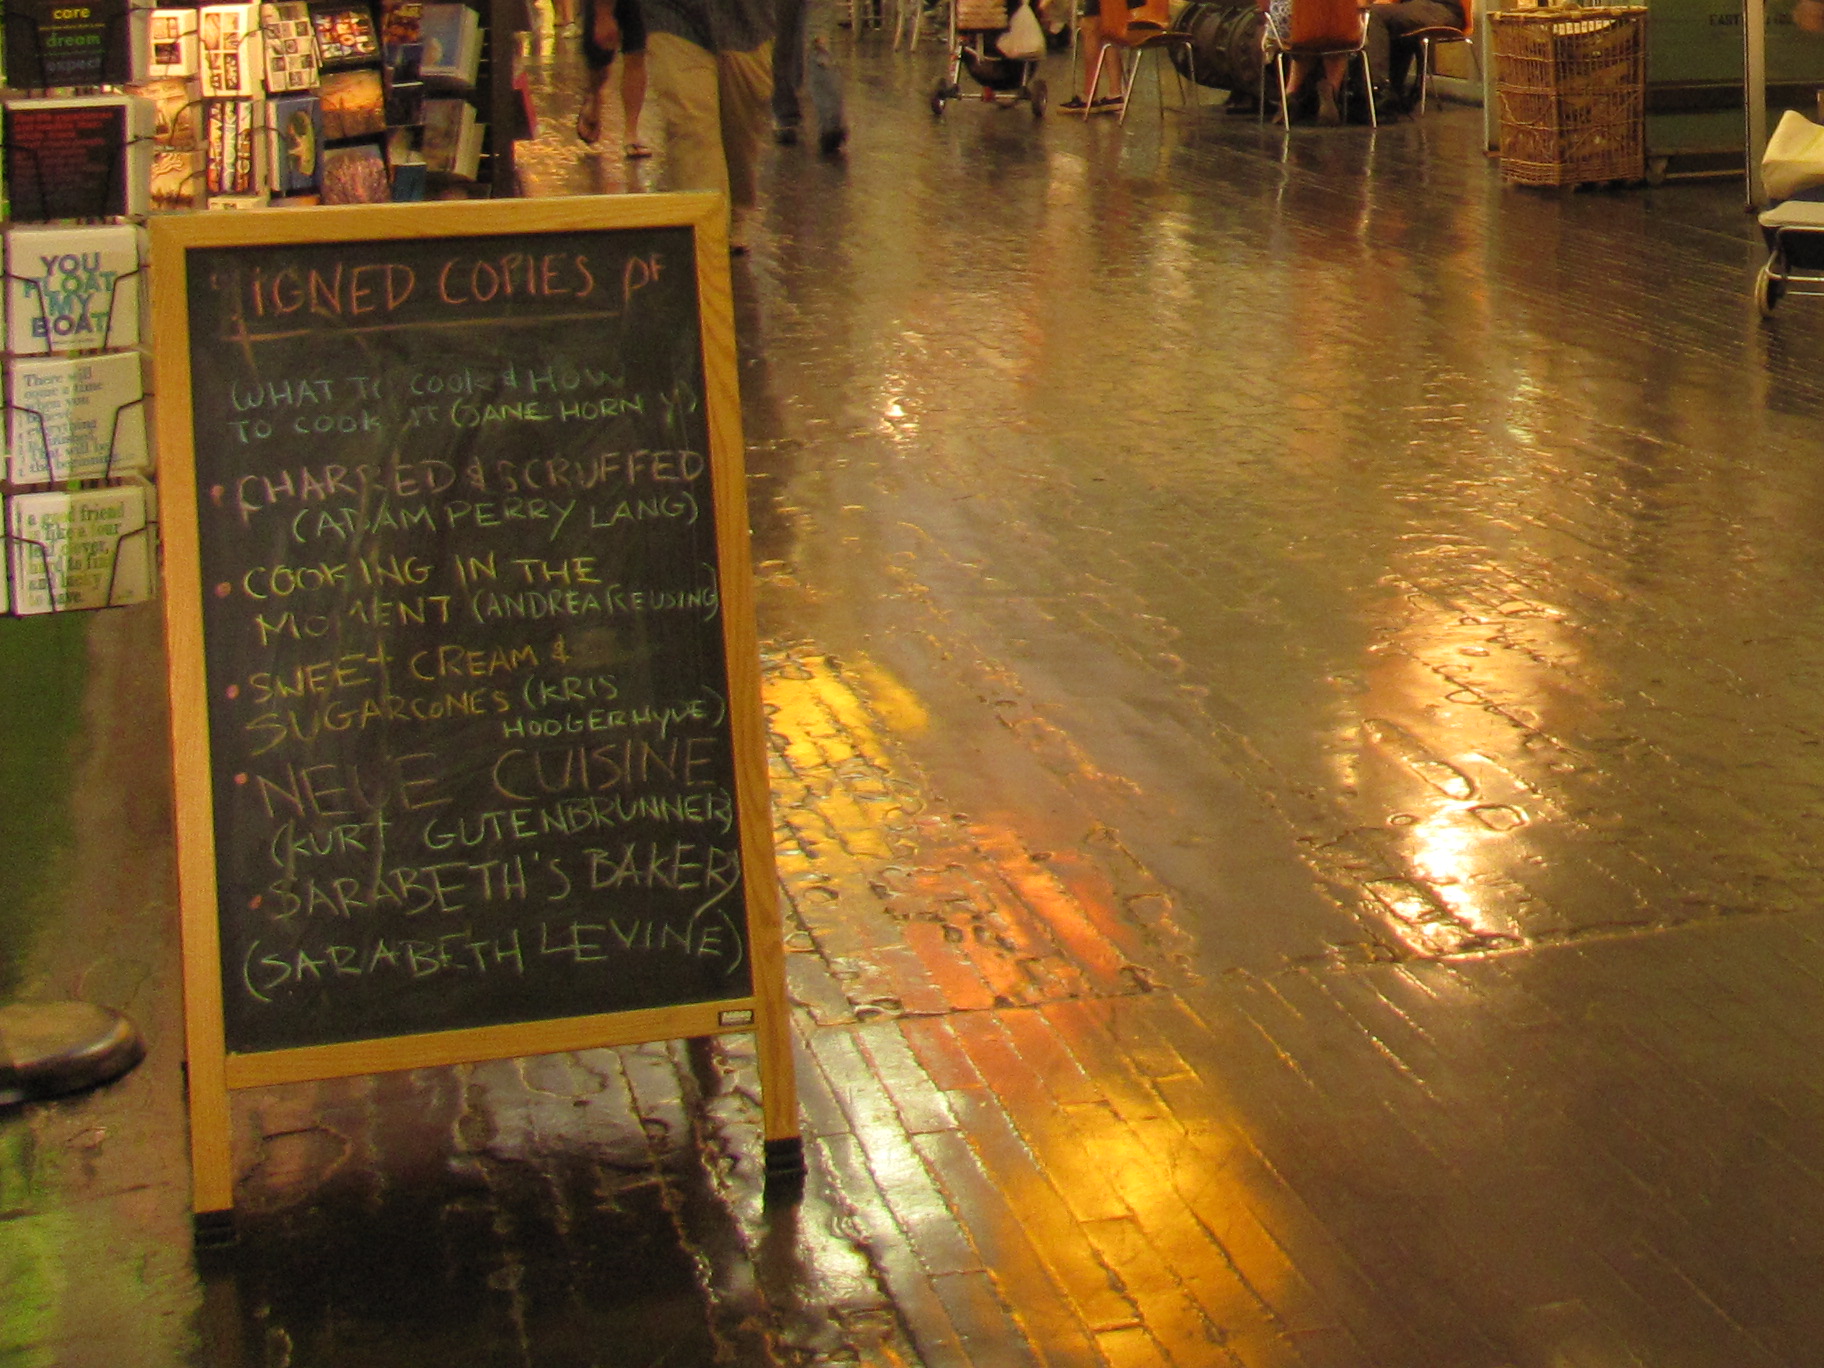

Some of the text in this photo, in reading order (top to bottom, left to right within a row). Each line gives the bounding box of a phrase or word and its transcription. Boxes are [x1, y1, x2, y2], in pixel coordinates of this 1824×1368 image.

[53, 7, 91, 20] care
[46, 32, 102, 47] dream
[23, 270, 117, 298] FLOAT
[40, 250, 101, 276] YOU
[437, 253, 597, 305] COPIES
[44, 290, 95, 317] MY
[231, 376, 334, 413] WHAT
[410, 367, 491, 395] COOK
[529, 367, 626, 394] HOW
[226, 418, 274, 444] TO
[293, 409, 383, 435] COOK
[499, 448, 704, 493] SCRUFFED
[292, 490, 699, 543] (ADAM PERRY LANG)
[242, 550, 602, 601] COOKING IN THE
[248, 636, 395, 705] SWEET
[409, 640, 539, 681] CREAM
[521, 674, 619, 710] (KRIS
[256, 735, 718, 819] NEUE CUISINE
[270, 806, 392, 868] (KURT
[269, 850, 572, 921] SARABETH'S
[242, 908, 743, 1004] (SARABETH LEVINE)
